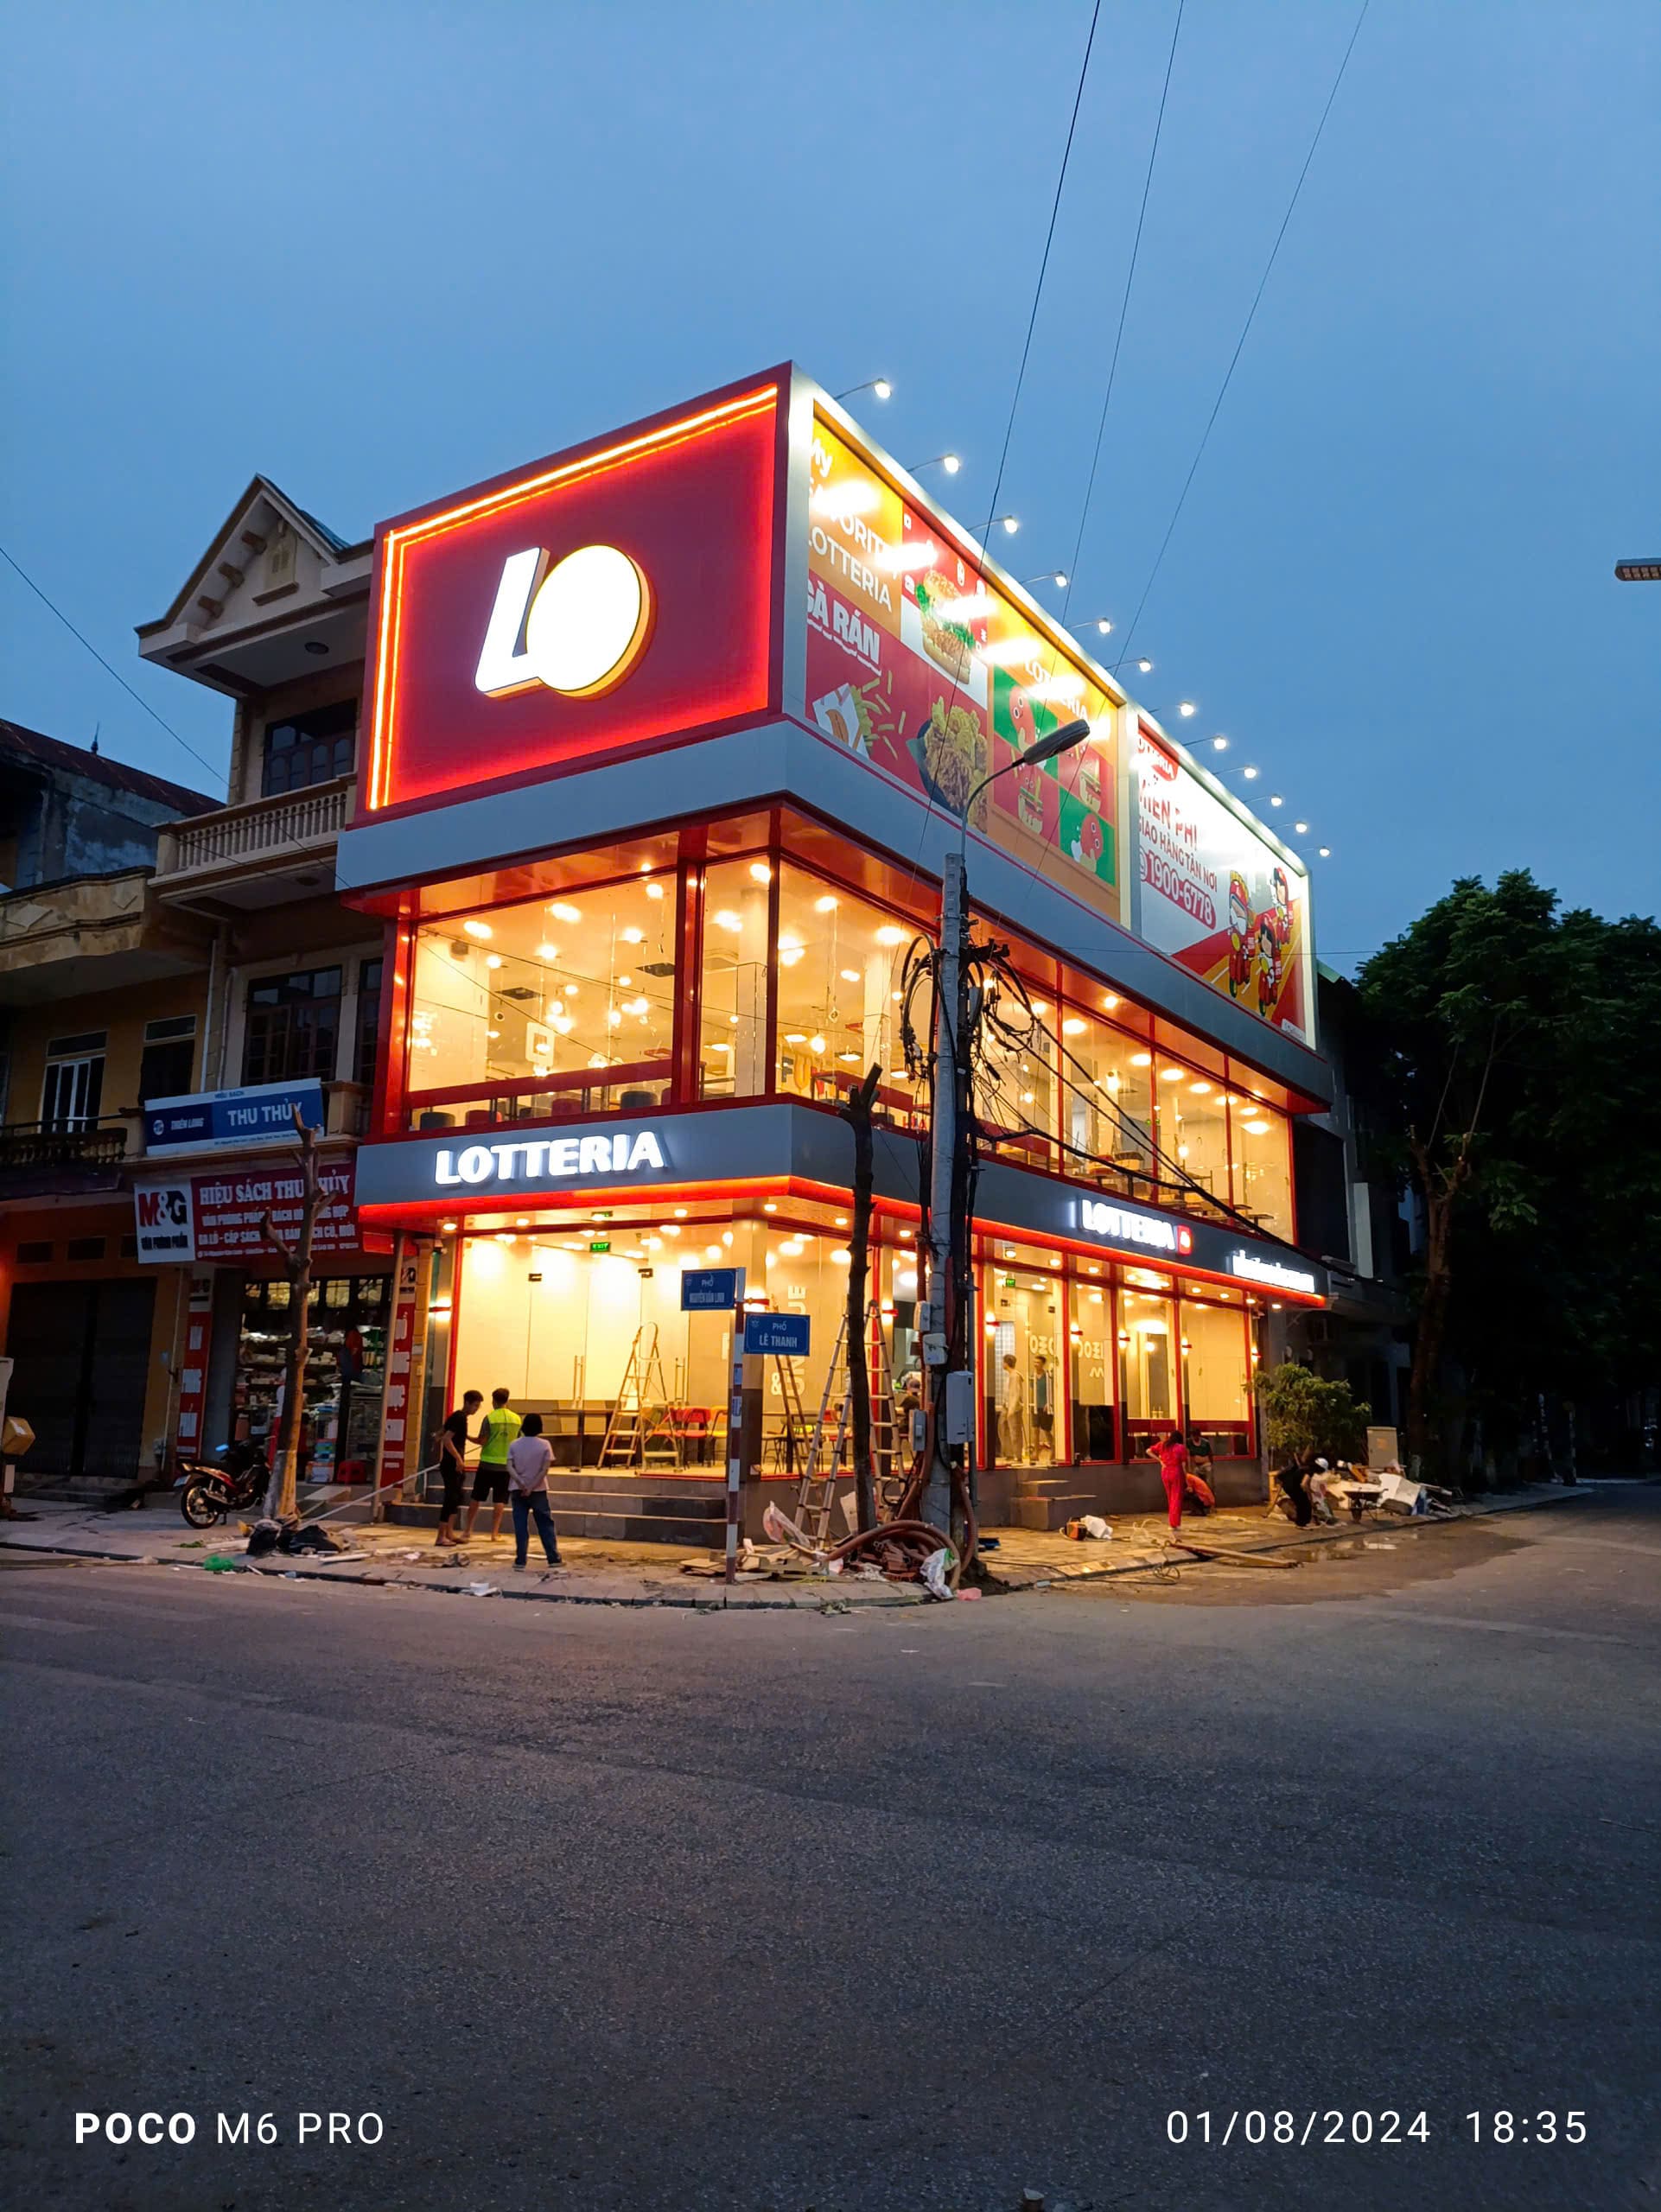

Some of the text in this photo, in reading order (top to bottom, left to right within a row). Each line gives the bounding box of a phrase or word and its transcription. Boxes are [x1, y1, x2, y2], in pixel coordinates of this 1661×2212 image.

[809, 525, 892, 613] OTTERIA
[833, 596, 881, 663] RÁN
[1149, 852, 1213, 926] 1900-6778
[228, 1107, 258, 1127] THU
[435, 1131, 665, 1185] LOTTERIA
[200, 1169, 350, 1209] HIỆU SÁCH THU HỦY
[138, 1190, 188, 1227] M&G
[592, 1243, 609, 1251] EXIT
[759, 1334, 769, 1346] LÊ
[773, 1320, 787, 1332] PHỐ
